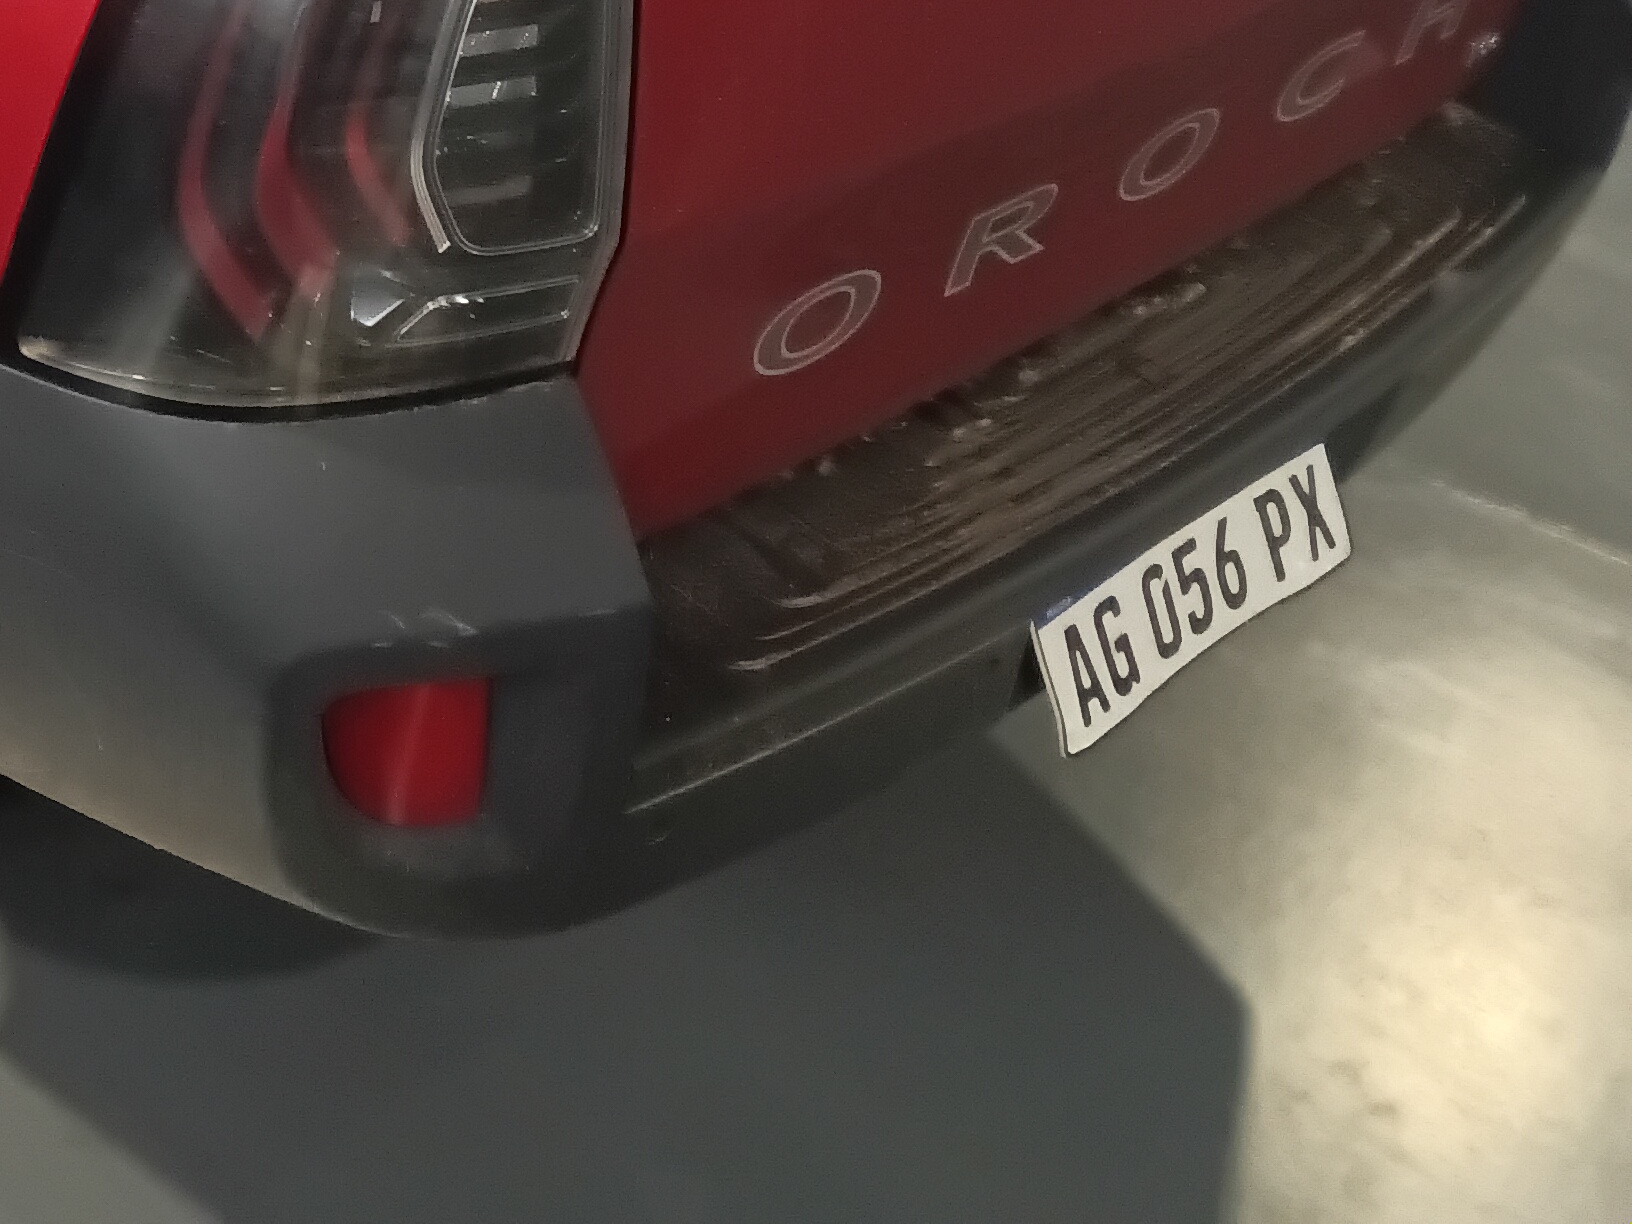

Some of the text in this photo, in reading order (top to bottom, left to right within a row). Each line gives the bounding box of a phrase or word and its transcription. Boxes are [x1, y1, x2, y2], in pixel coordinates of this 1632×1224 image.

[1063, 464, 1336, 728] AG 056 PX
